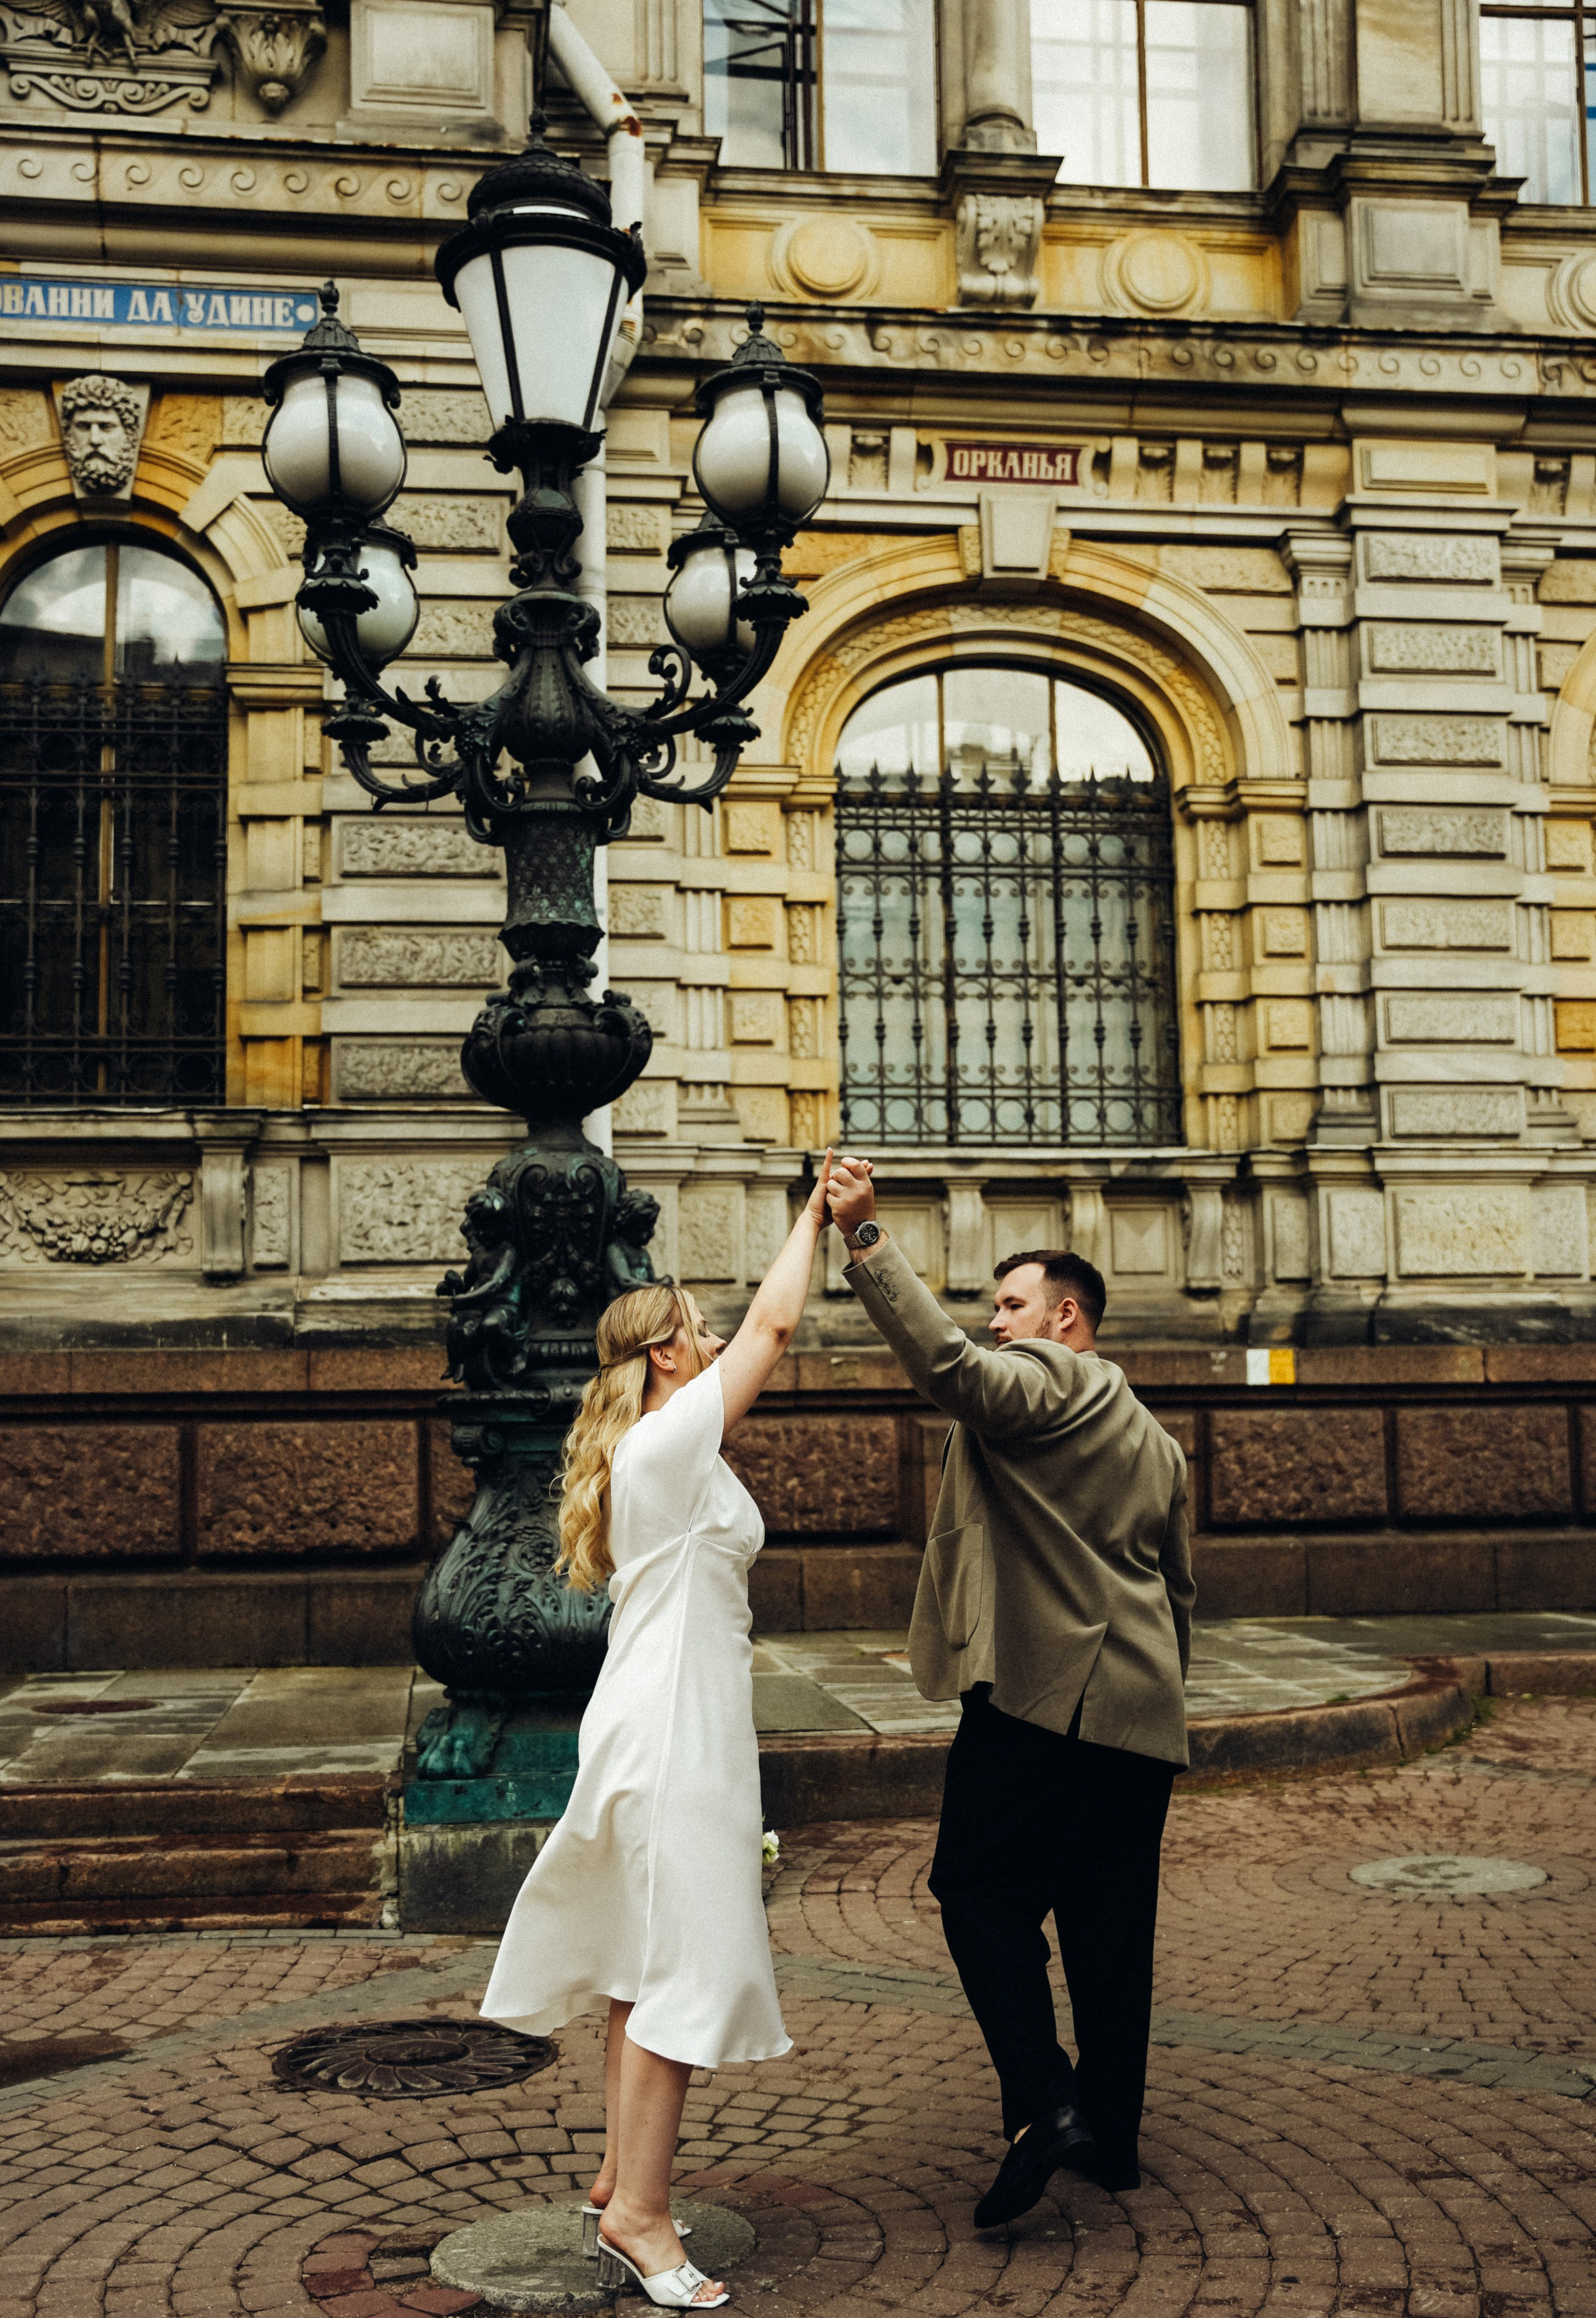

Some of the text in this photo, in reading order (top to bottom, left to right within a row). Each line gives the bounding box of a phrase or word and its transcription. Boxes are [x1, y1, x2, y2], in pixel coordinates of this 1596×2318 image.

[0, 284, 294, 327] ВАННИ ДА УДИНЕ
[953, 449, 1072, 481] ОРКАНЬЯ
